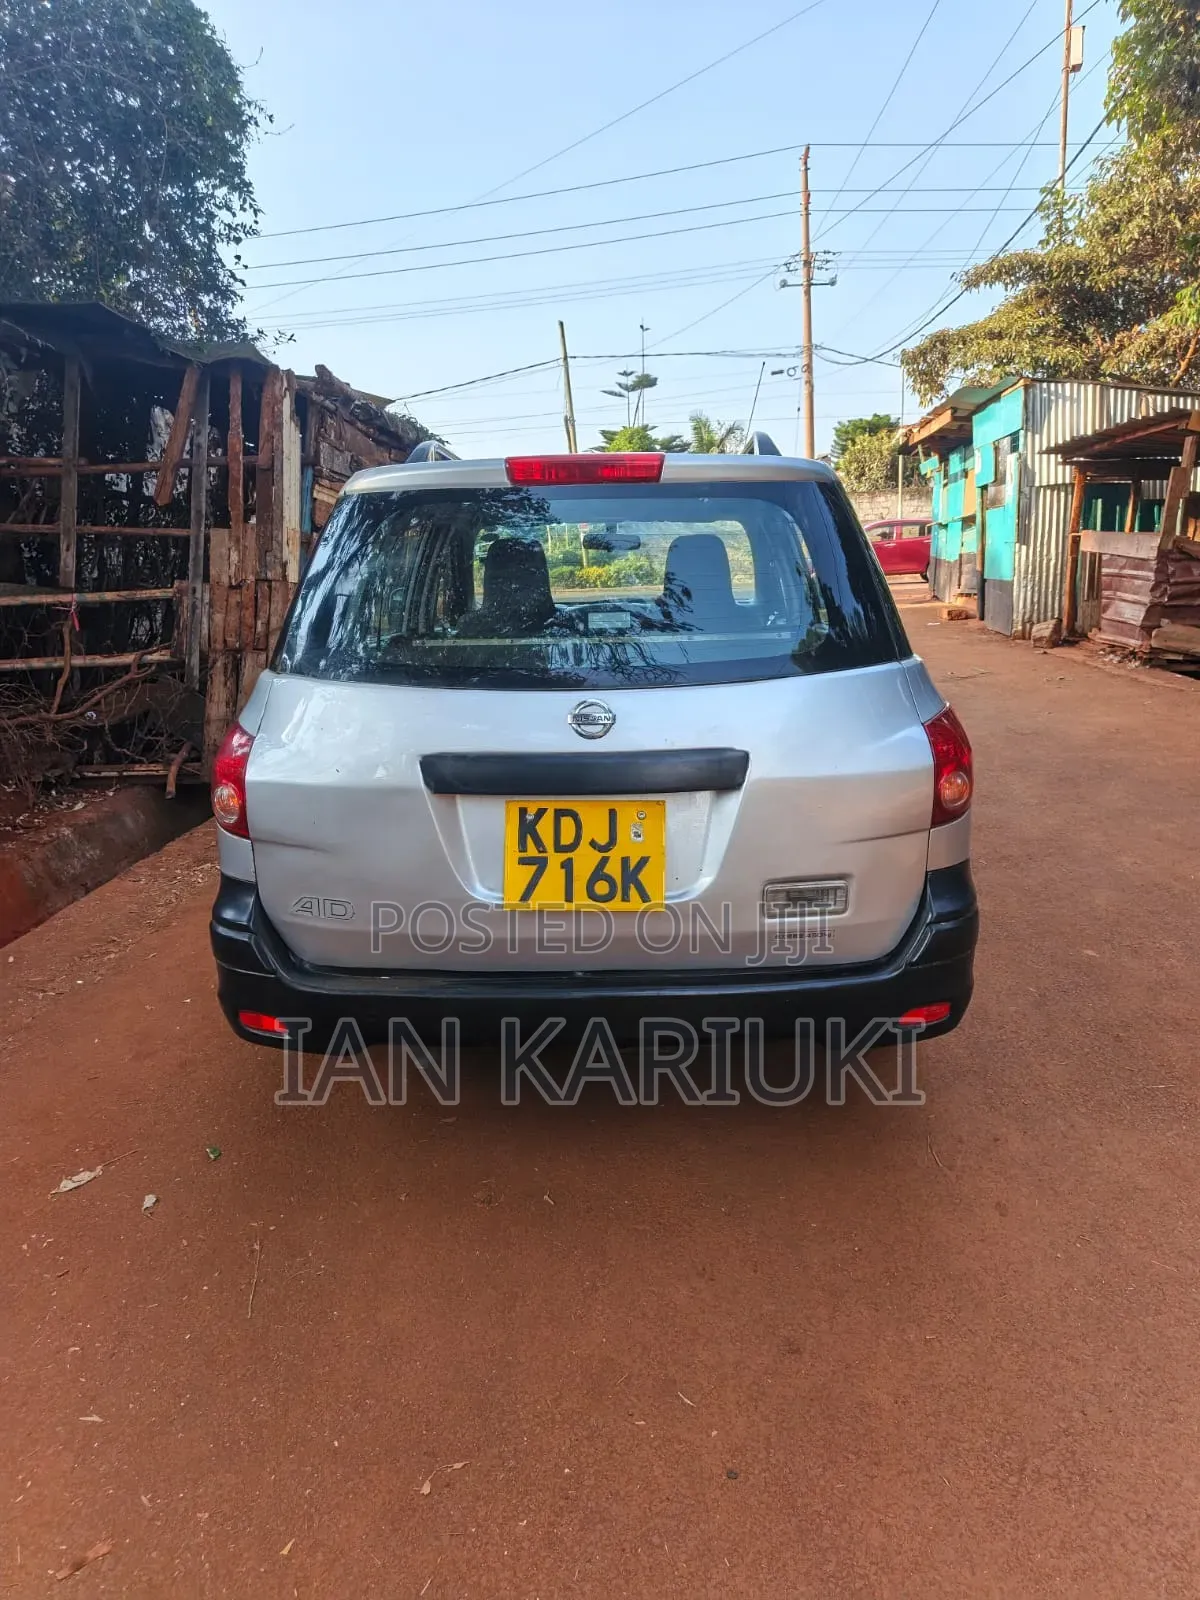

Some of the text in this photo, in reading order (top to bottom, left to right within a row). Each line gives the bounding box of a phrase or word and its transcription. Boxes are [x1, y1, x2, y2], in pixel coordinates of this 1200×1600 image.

[572, 714, 611, 722] NISSAN
[517, 806, 618, 853] KDJ
[517, 856, 652, 903] 716K
